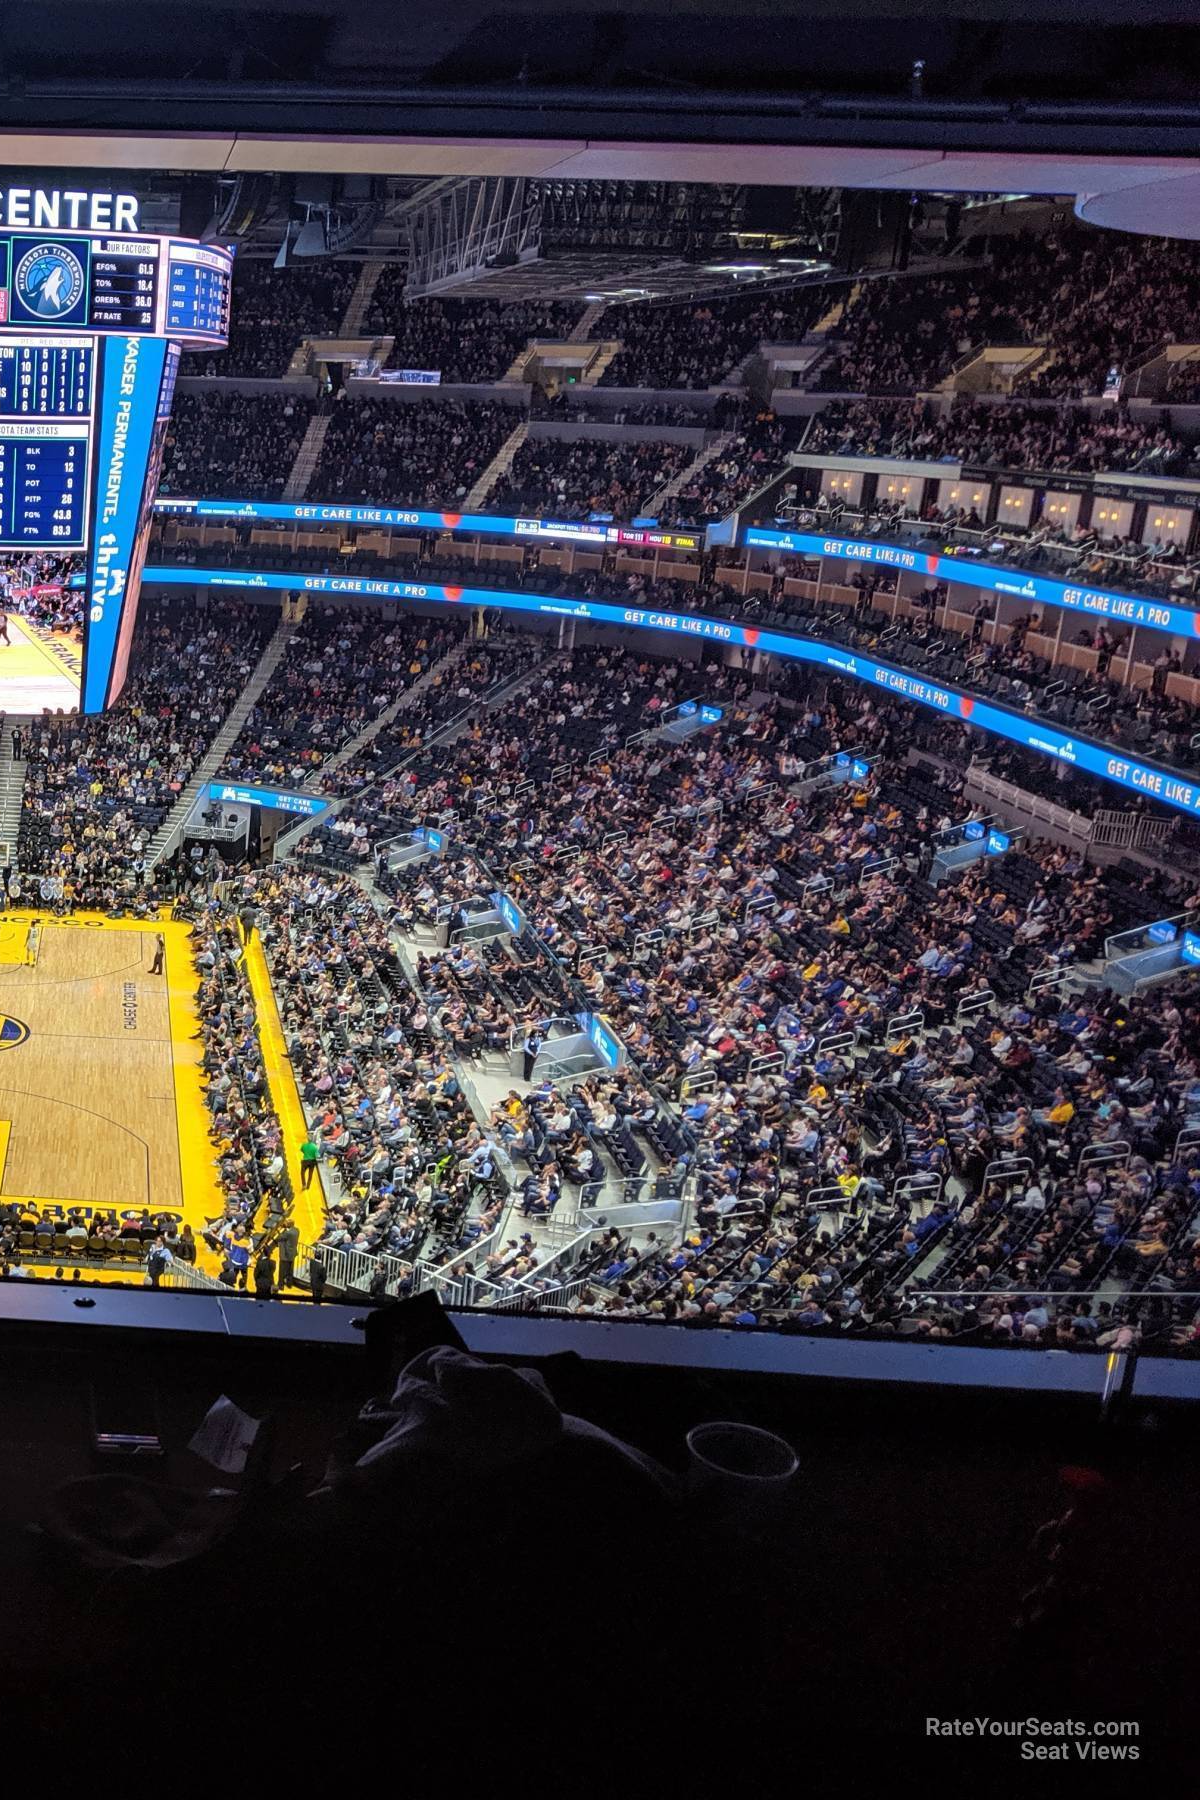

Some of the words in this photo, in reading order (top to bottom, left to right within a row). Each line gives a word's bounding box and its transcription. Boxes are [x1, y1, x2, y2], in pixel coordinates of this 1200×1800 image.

[106, 242, 120, 252] OUR
[122, 244, 150, 253] FACTORS
[19, 249, 49, 290] MINNESOTA
[53, 249, 80, 306] TIMBERWOLVES
[139, 264, 153, 275] 61.5
[138, 280, 152, 291] 18.4
[141, 313, 150, 323] 25
[120, 337, 140, 396] KAISER
[17, 426, 36, 434] TEAM
[295, 508, 316, 517] GET
[322, 509, 351, 518] CARE
[357, 512, 381, 520] LIKE
[386, 513, 392, 521] A
[397, 514, 418, 523] PRO
[824, 542, 842, 553] GET
[846, 545, 871, 557] CARE
[876, 550, 894, 562] LIKE
[895, 553, 900, 562] A
[901, 555, 915, 567] PRO
[89, 533, 118, 622] thrive
[305, 579, 325, 588] GET
[332, 581, 361, 590] CARE
[366, 583, 388, 592] LIKE
[393, 585, 400, 593] A
[405, 586, 426, 596] PRO
[1064, 589, 1080, 604] GET
[1084, 594, 1109, 611] CARE
[1112, 600, 1133, 616] LIKE
[1136, 606, 1143, 619] A
[1148, 608, 1170, 625] PRO
[625, 611, 645, 622] GET
[649, 615, 677, 627] CARE
[682, 619, 701, 631] LIKE
[705, 624, 710, 632] A
[714, 626, 730, 637] PRO
[1108, 760, 1130, 779] GET
[1132, 769, 1162, 792] CARE
[1165, 782, 1192, 804] LIKE
[124, 982, 136, 1001] CENTER
[124, 1009, 136, 1029] CHASE
